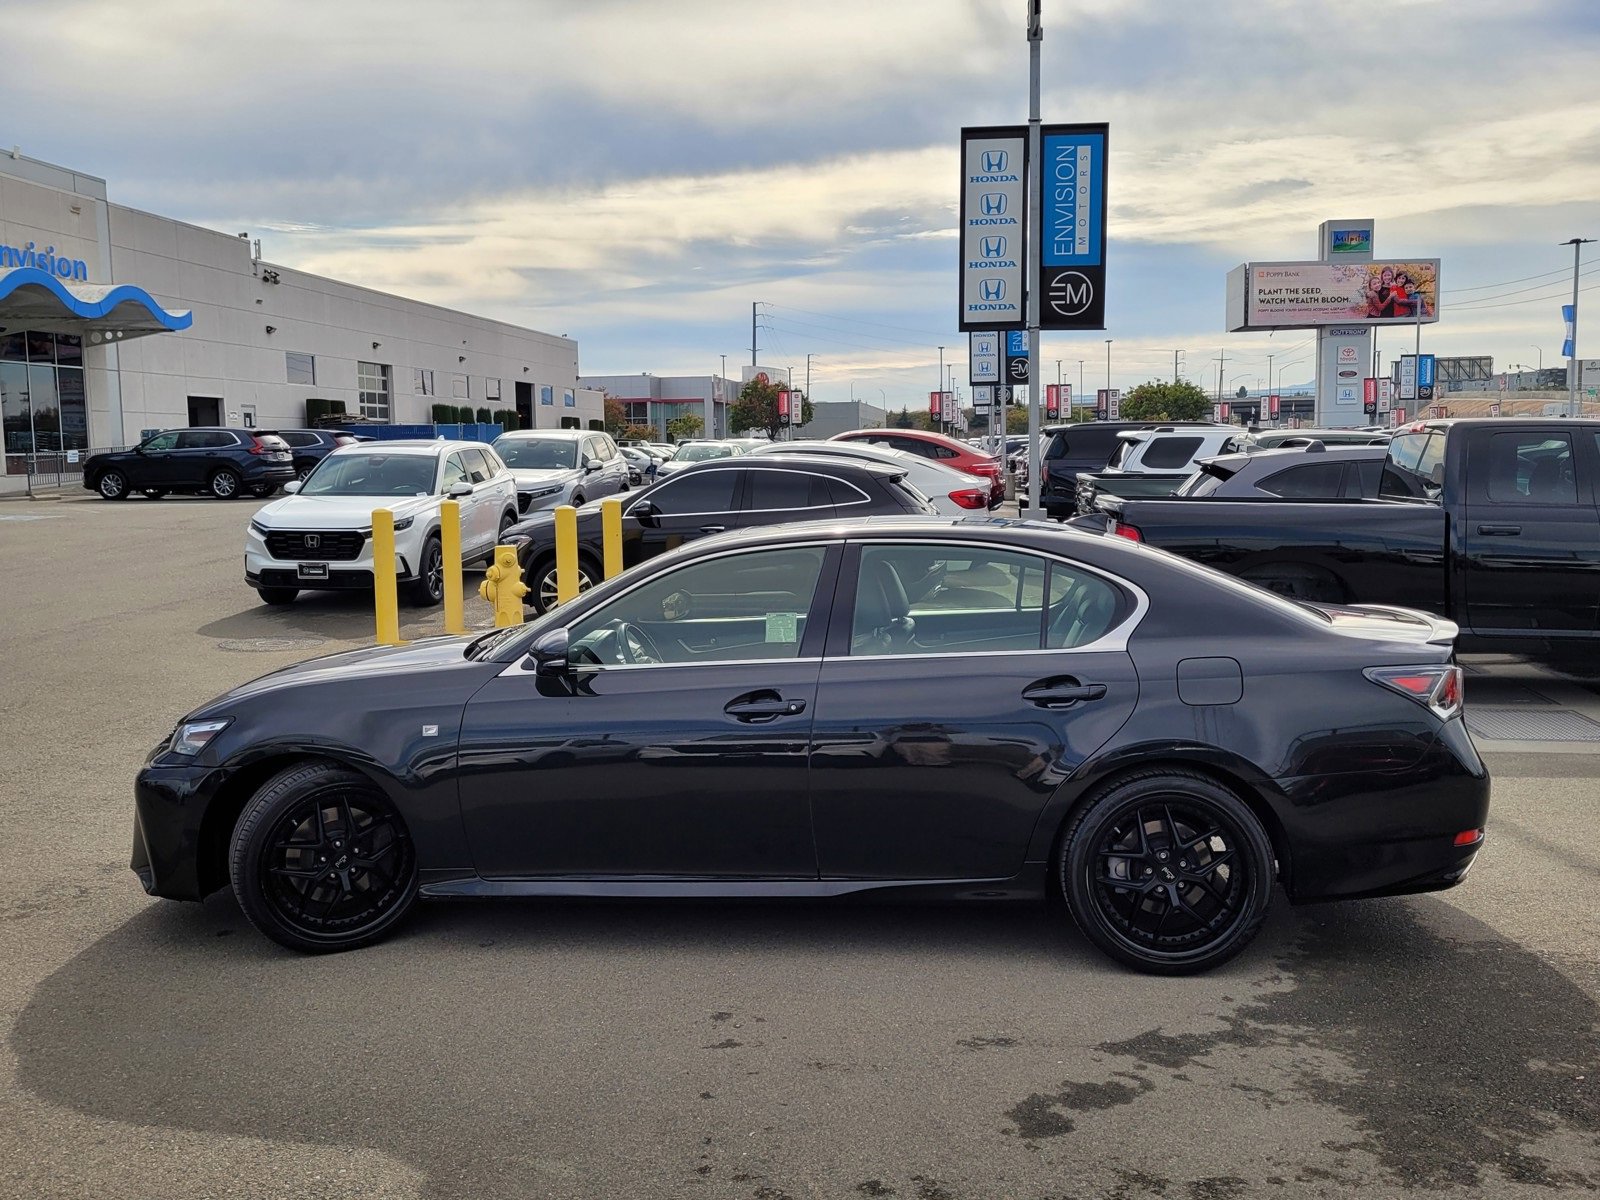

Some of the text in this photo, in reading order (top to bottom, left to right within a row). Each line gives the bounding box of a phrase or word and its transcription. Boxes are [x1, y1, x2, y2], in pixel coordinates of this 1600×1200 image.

[969, 174, 1019, 183] HONDA
[1054, 145, 1075, 256] ENVISION
[1078, 155, 1088, 246] MOTORS
[968, 217, 1018, 226] HONDA
[0, 241, 88, 281] nvision
[968, 260, 1017, 268] HONDA
